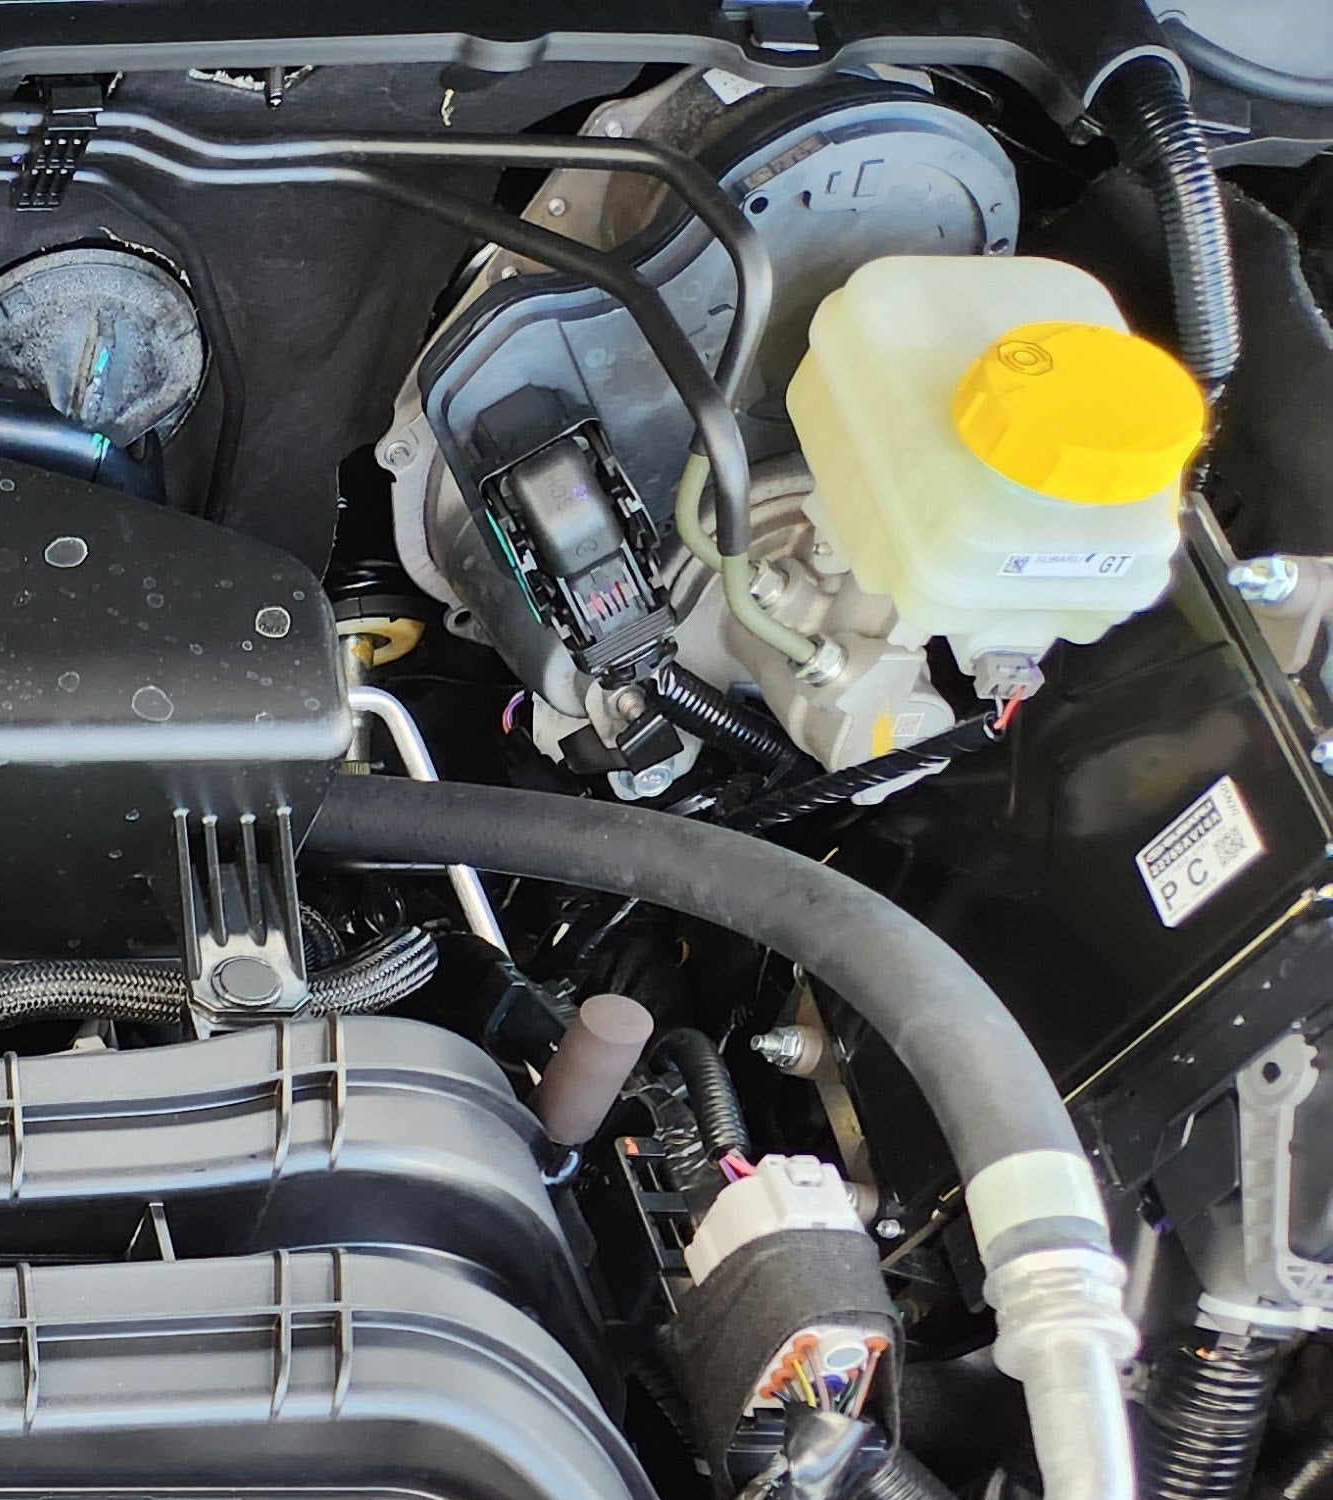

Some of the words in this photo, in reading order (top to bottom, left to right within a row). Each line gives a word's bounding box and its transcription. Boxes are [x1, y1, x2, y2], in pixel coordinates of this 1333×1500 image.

[1034, 555, 1083, 564] SUBARU
[1098, 555, 1132, 574] GT
[1220, 783, 1240, 816] DENSO
[1160, 880, 1178, 911] P
[1187, 858, 1208, 886] C
